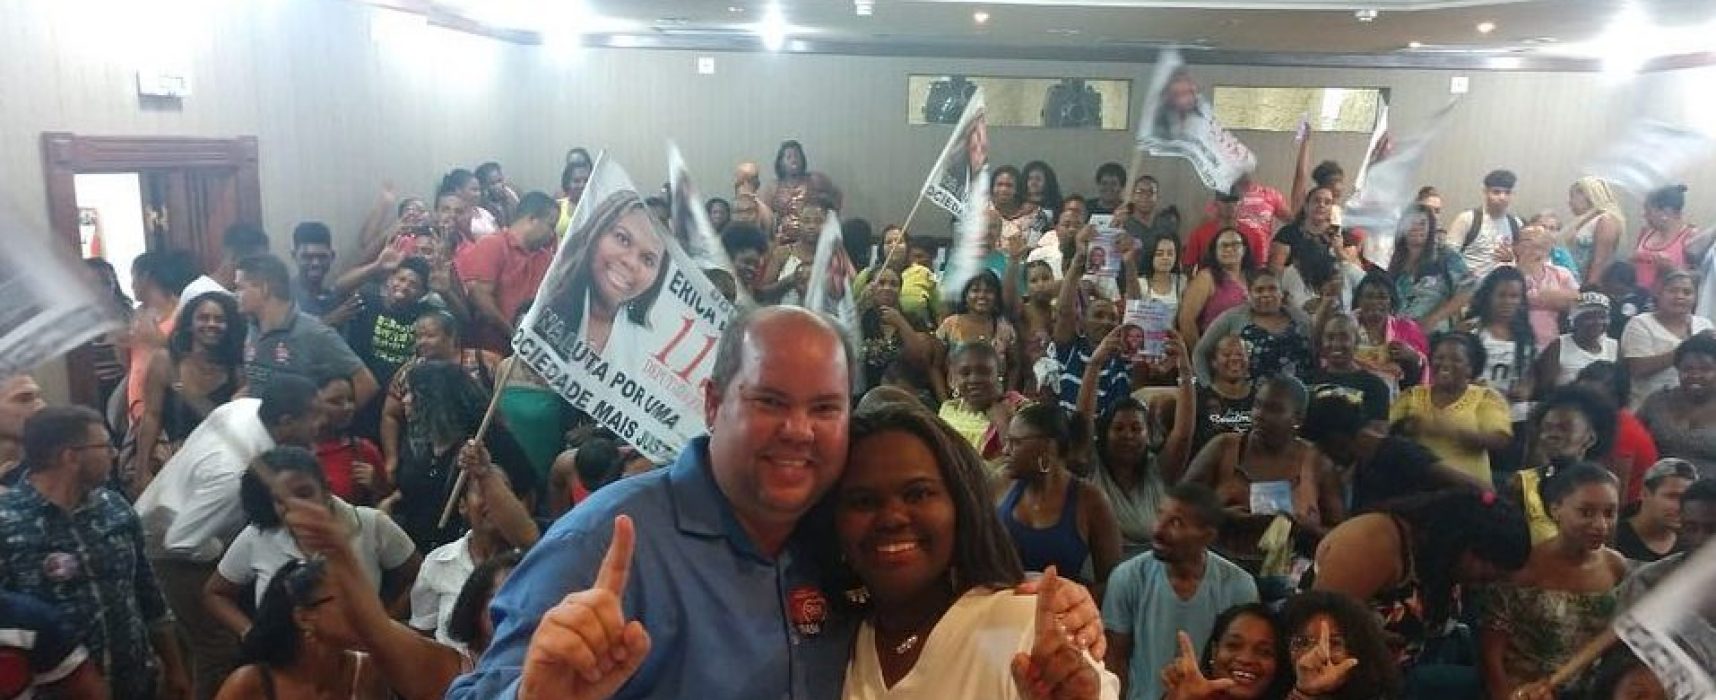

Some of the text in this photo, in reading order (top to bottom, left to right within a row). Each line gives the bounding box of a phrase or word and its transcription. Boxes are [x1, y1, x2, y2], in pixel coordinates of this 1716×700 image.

[670, 270, 716, 325] ERICA
[648, 316, 718, 388] 11
[591, 400, 639, 438] MAIS
[609, 371, 646, 407] POR
[644, 394, 681, 430] UMA
